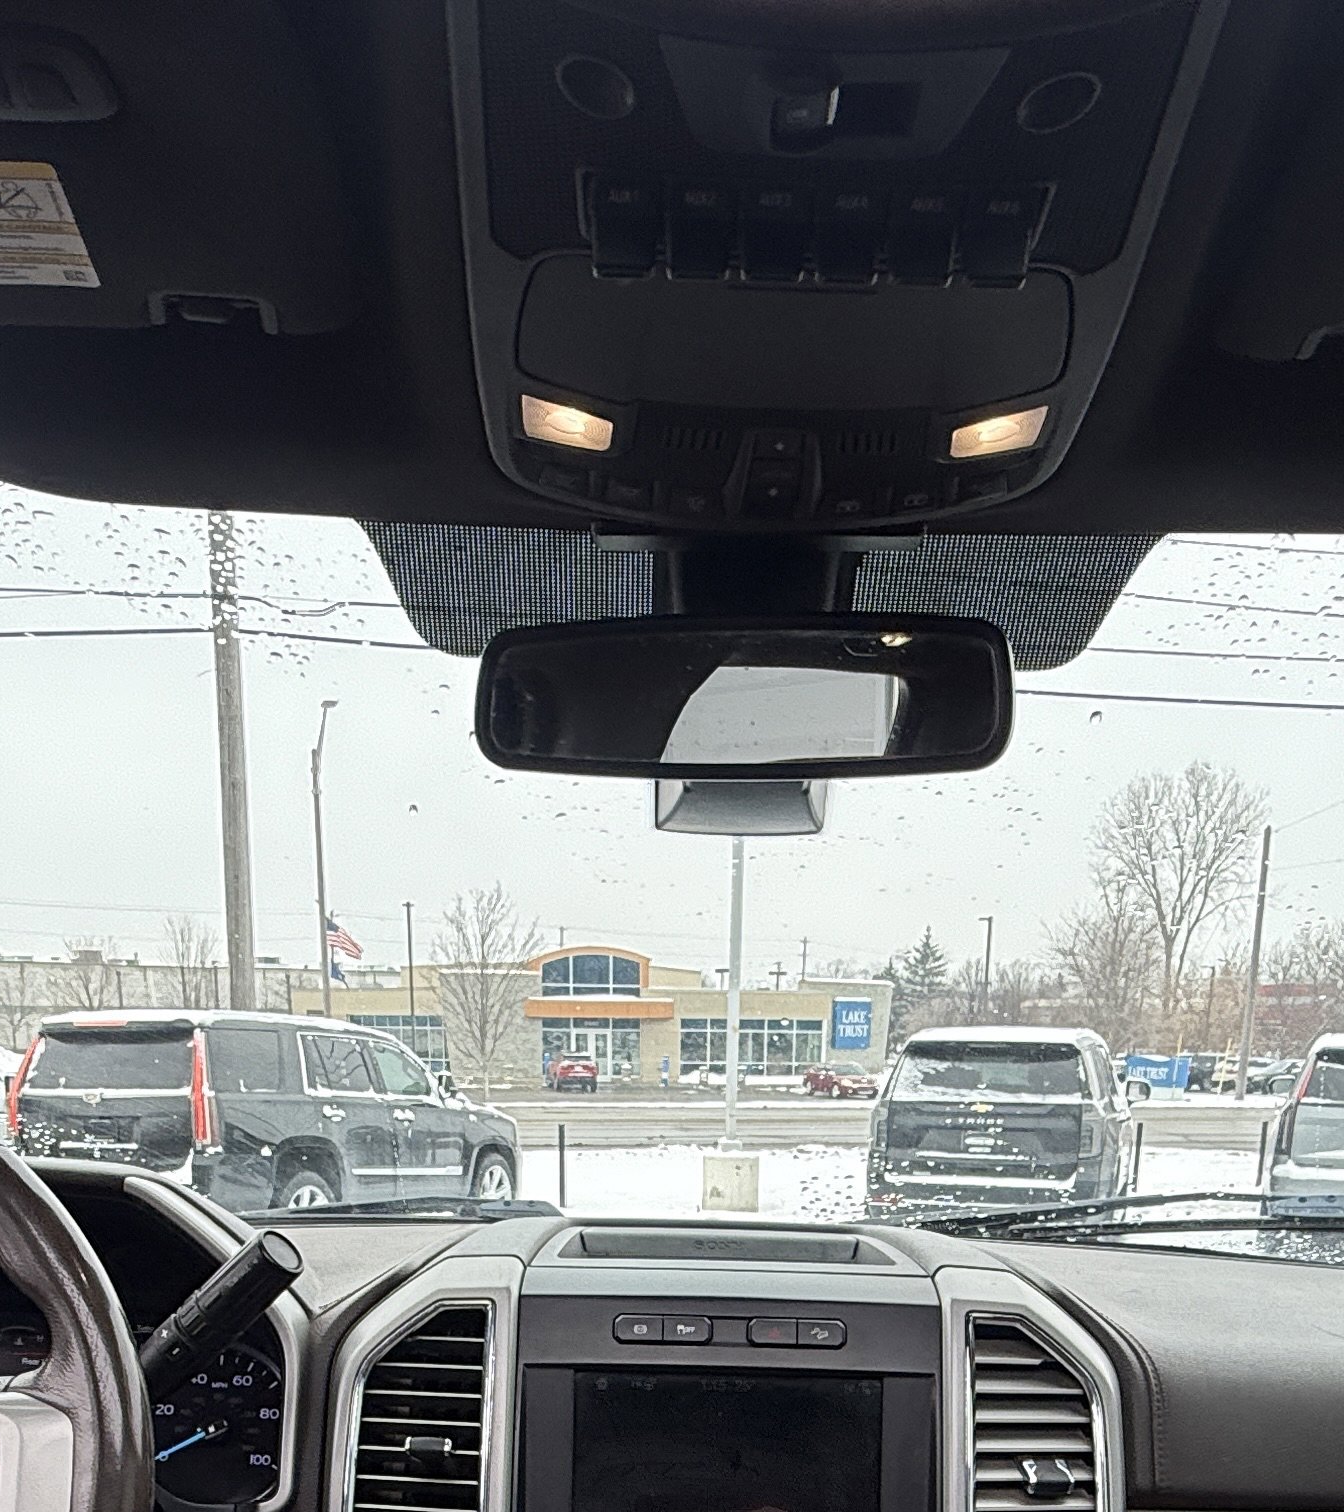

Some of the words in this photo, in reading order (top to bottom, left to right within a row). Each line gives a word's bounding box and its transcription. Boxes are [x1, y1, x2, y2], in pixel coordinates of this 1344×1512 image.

[841, 1009, 868, 1025] LAKE
[838, 1024, 869, 1038] TRUST
[232, 1375, 253, 1387] 60
[155, 1404, 175, 1416] 20
[259, 1408, 280, 1420] 80
